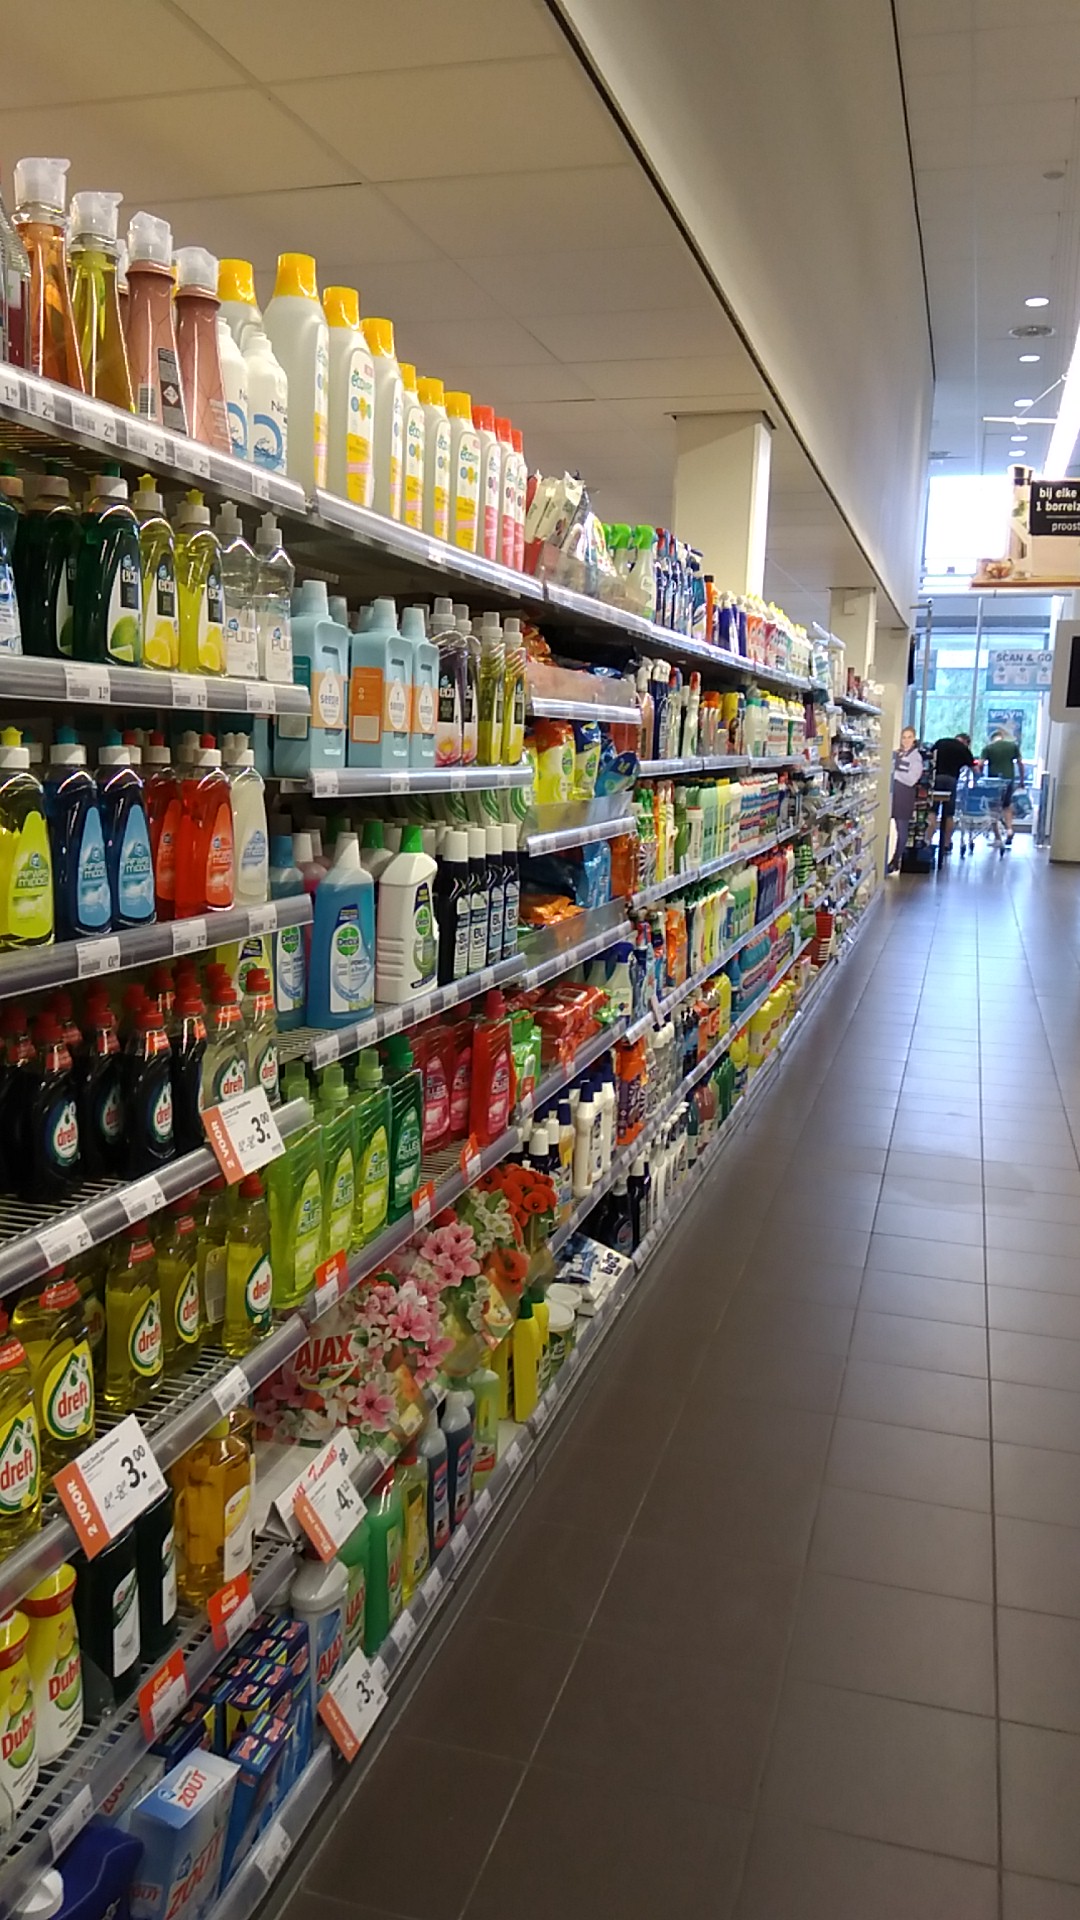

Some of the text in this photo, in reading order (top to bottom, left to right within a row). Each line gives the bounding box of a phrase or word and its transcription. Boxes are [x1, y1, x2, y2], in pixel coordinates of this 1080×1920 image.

[1036, 501, 1041, 511] 1
[1039, 487, 1077, 500] bij elke
[996, 653, 1052, 662] SCAN & GO
[223, 1075, 243, 1095] dreft
[210, 1119, 236, 1169] 2 VOOR
[294, 1332, 354, 1377] AJAX
[57, 1381, 88, 1418] dreft
[1, 1447, 33, 1490] dreft
[66, 1479, 99, 1538] 2 VOOR
[177, 1769, 208, 1808] ZOUT
